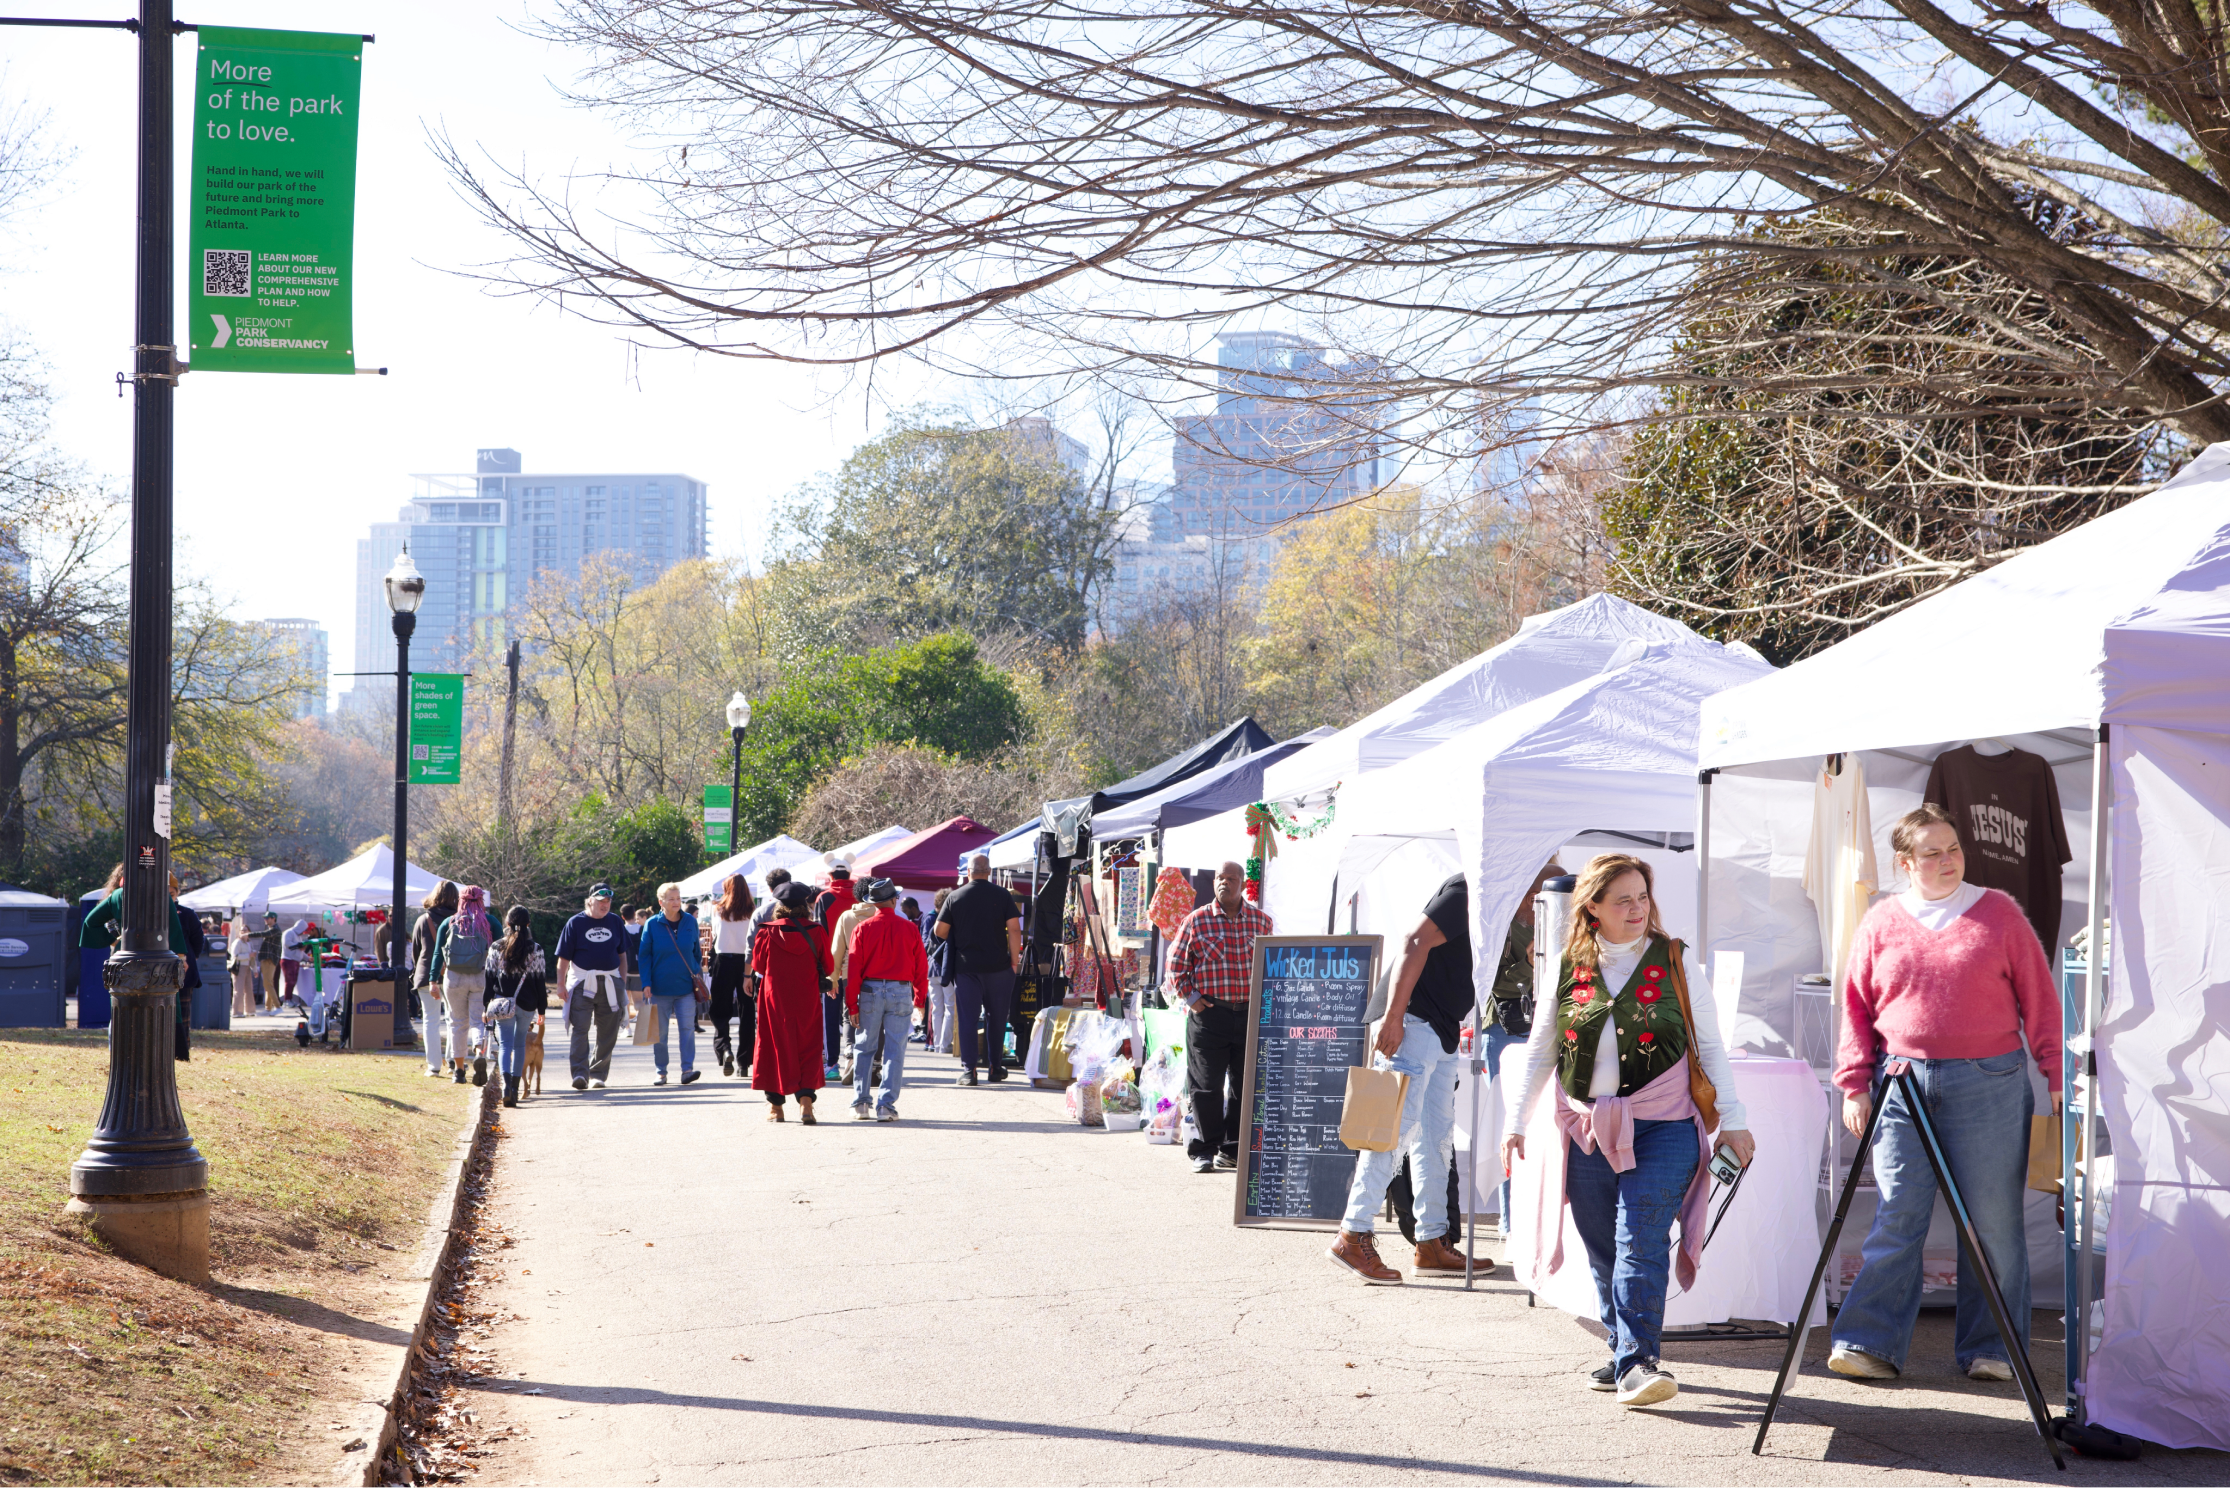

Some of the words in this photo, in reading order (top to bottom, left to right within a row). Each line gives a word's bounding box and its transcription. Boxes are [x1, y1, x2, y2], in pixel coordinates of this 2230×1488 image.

[211, 59, 272, 81] More
[208, 89, 233, 109] of
[241, 90, 280, 112] the
[289, 94, 343, 117] park
[207, 120, 231, 139] to
[239, 119, 295, 142] love.
[206, 165, 235, 175] Hand
[238, 166, 248, 176] in
[251, 167, 282, 178] hand,
[285, 170, 301, 178] we
[304, 170, 324, 179] will
[206, 179, 234, 188] build
[237, 181, 255, 189] our
[258, 181, 282, 192] park
[285, 182, 296, 191] of
[298, 183, 316, 192] the
[206, 192, 239, 202] future
[242, 194, 262, 203] and
[266, 194, 294, 206] bring
[296, 197, 324, 205] more
[205, 206, 258, 216] Piedmont
[261, 208, 286, 218] Park
[289, 209, 300, 218] to
[205, 219, 249, 230] Atlanta.
[258, 253, 289, 262] LEARN
[291, 254, 318, 262] MORE
[258, 265, 290, 273] ABOUT
[292, 265, 312, 274] OUR
[315, 266, 336, 274] NEW
[258, 276, 339, 286] COMPREHENSIVE
[258, 287, 282, 295] PLAN
[285, 288, 305, 296] AND
[307, 288, 330, 297] HOW
[258, 298, 270, 306] TO
[273, 299, 299, 307] HELP.
[235, 317, 292, 328] PIEDMONT
[235, 328, 268, 337] PARK
[236, 338, 329, 349] CONSERVANCY
[415, 691, 443, 699] shades
[415, 702, 437, 710] green
[415, 712, 440, 720] space.
[2002, 855, 2019, 864] AMEN
[1320, 947, 1359, 979] Juls
[1296, 981, 1314, 992] Candle
[1325, 981, 1342, 990] Room
[1346, 982, 1365, 995] Spray
[1301, 993, 1320, 1002] Candle
[1326, 992, 1343, 1003] Body
[360, 1004, 388, 1013] LOWE'S
[1260, 989, 1272, 1024] Products
[1321, 1003, 1331, 1011] Car
[1333, 1004, 1356, 1012] diffuser
[1293, 1008, 1312, 1019] Candle
[1317, 1013, 1332, 1021] Room
[1333, 1014, 1356, 1022] diffuser
[1253, 1099, 1265, 1123] Floral
[1248, 1173, 1259, 1205] Earthy
